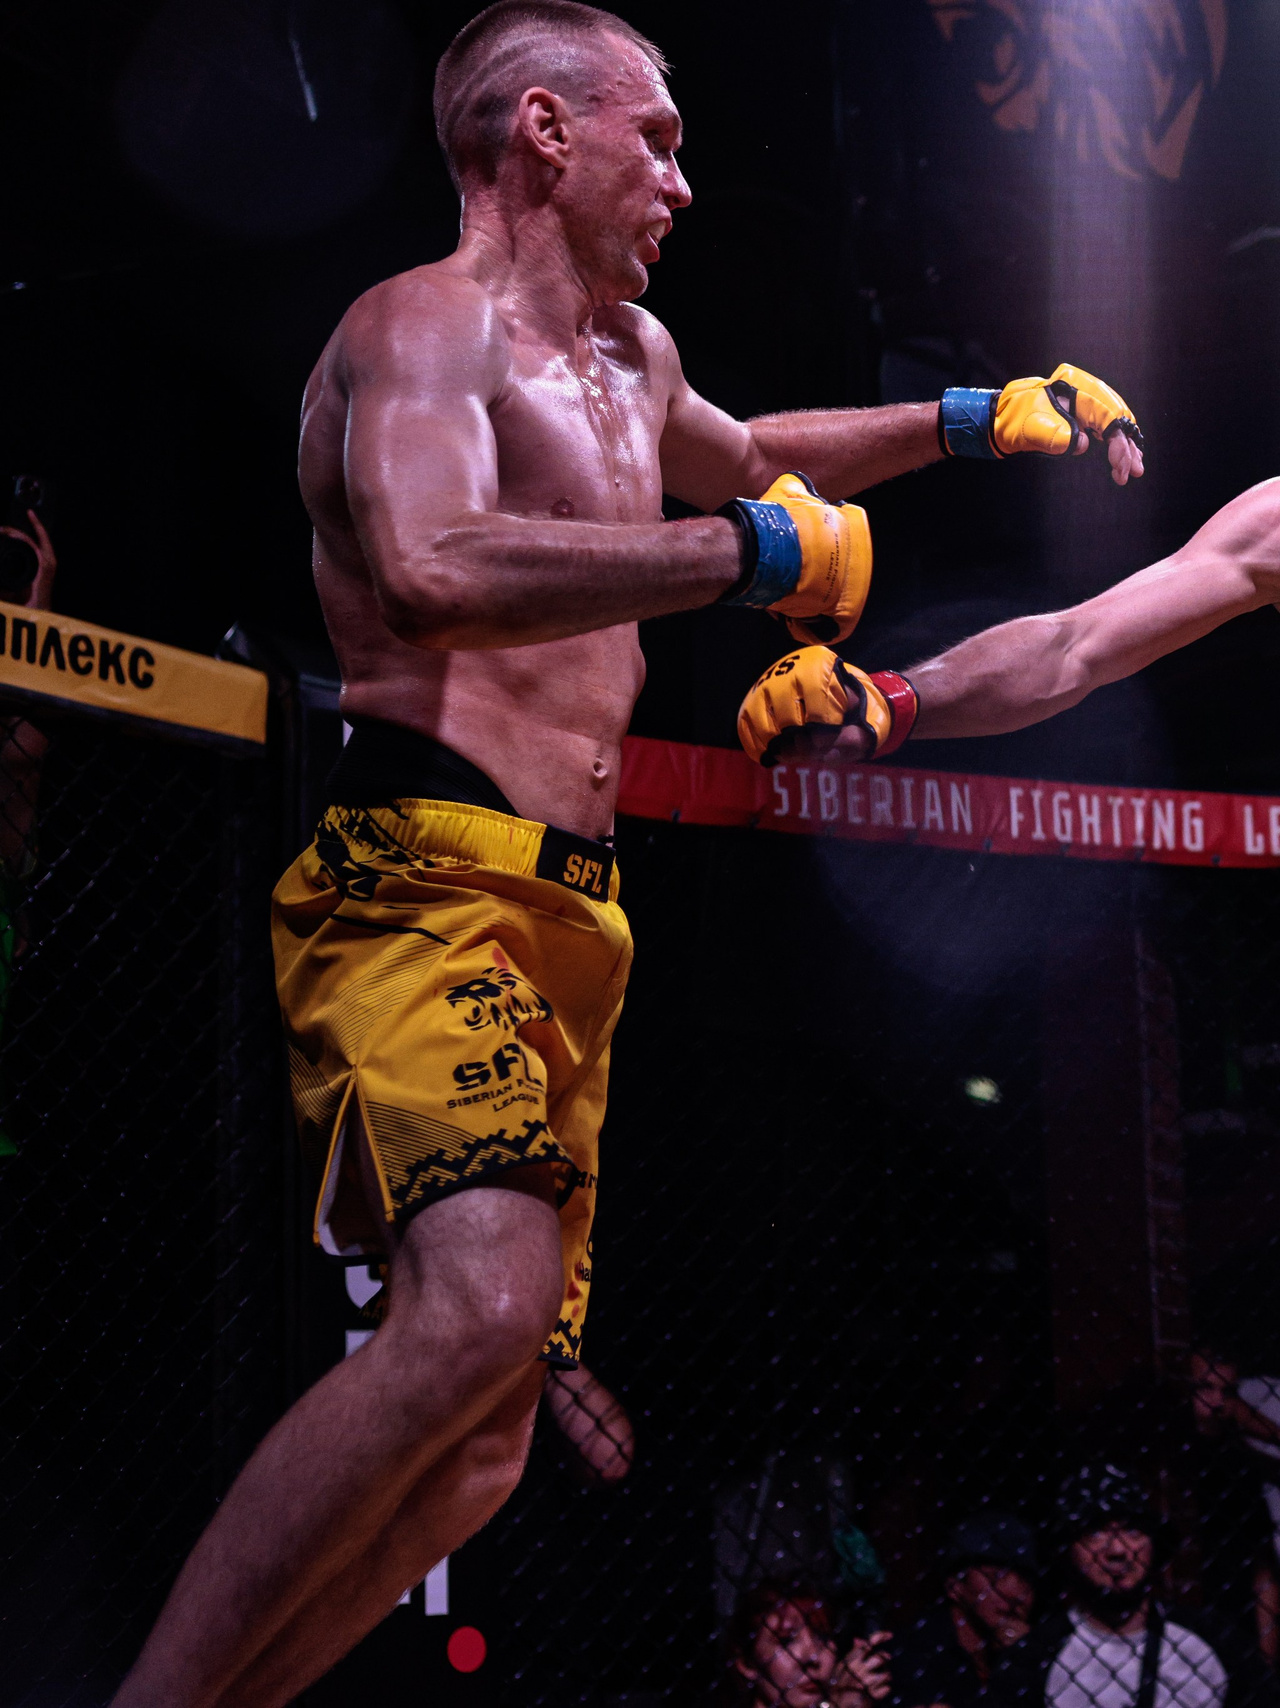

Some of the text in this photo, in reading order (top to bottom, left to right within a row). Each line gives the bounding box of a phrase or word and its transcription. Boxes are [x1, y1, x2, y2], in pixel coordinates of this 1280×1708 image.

[0, 611, 155, 690] плекс
[771, 765, 974, 836] SIBERIAN
[1008, 787, 1205, 853] FIGHTING
[563, 852, 604, 893] SFL
[446, 1083, 513, 1109] SIBERIAN
[493, 1093, 540, 1113] LEAGUE
